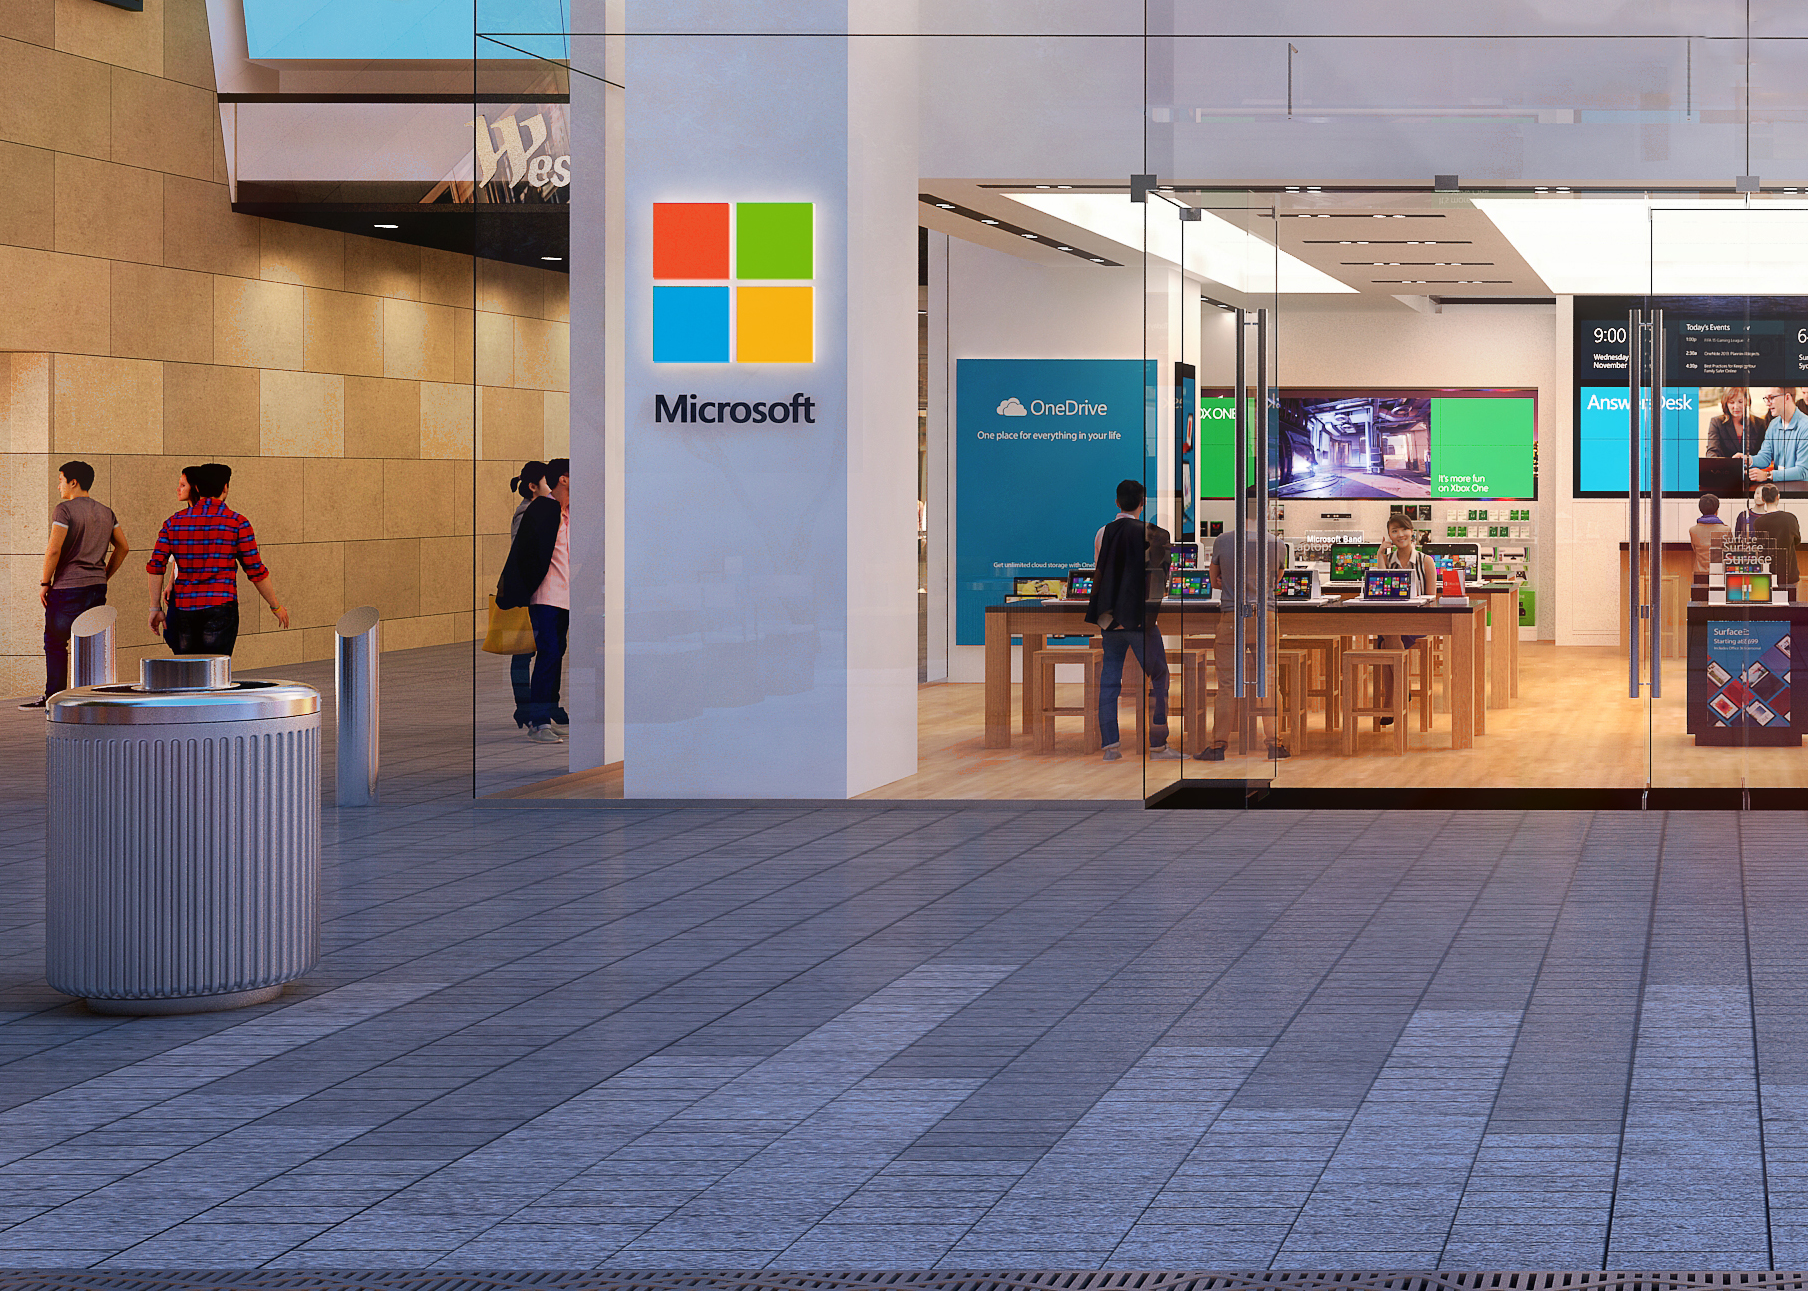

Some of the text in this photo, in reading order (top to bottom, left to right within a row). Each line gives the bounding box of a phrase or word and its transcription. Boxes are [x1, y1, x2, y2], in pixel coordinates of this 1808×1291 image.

[1686, 323, 1731, 332] Today's Events
[1593, 327, 1627, 344] 9:00
[1593, 353, 1630, 361] Wednesday
[1030, 399, 1108, 416] OneDrive
[1587, 394, 1646, 411] Answr
[655, 392, 816, 424] Microsoft
[977, 430, 1122, 442] One place for everything in your life
[1438, 473, 1486, 483] It's more fun
[1438, 483, 1489, 493] on Xbox One
[1307, 534, 1363, 543] Microsoft Band
[1047, 561, 1068, 569] storage
[1713, 628, 1742, 636] Surface
